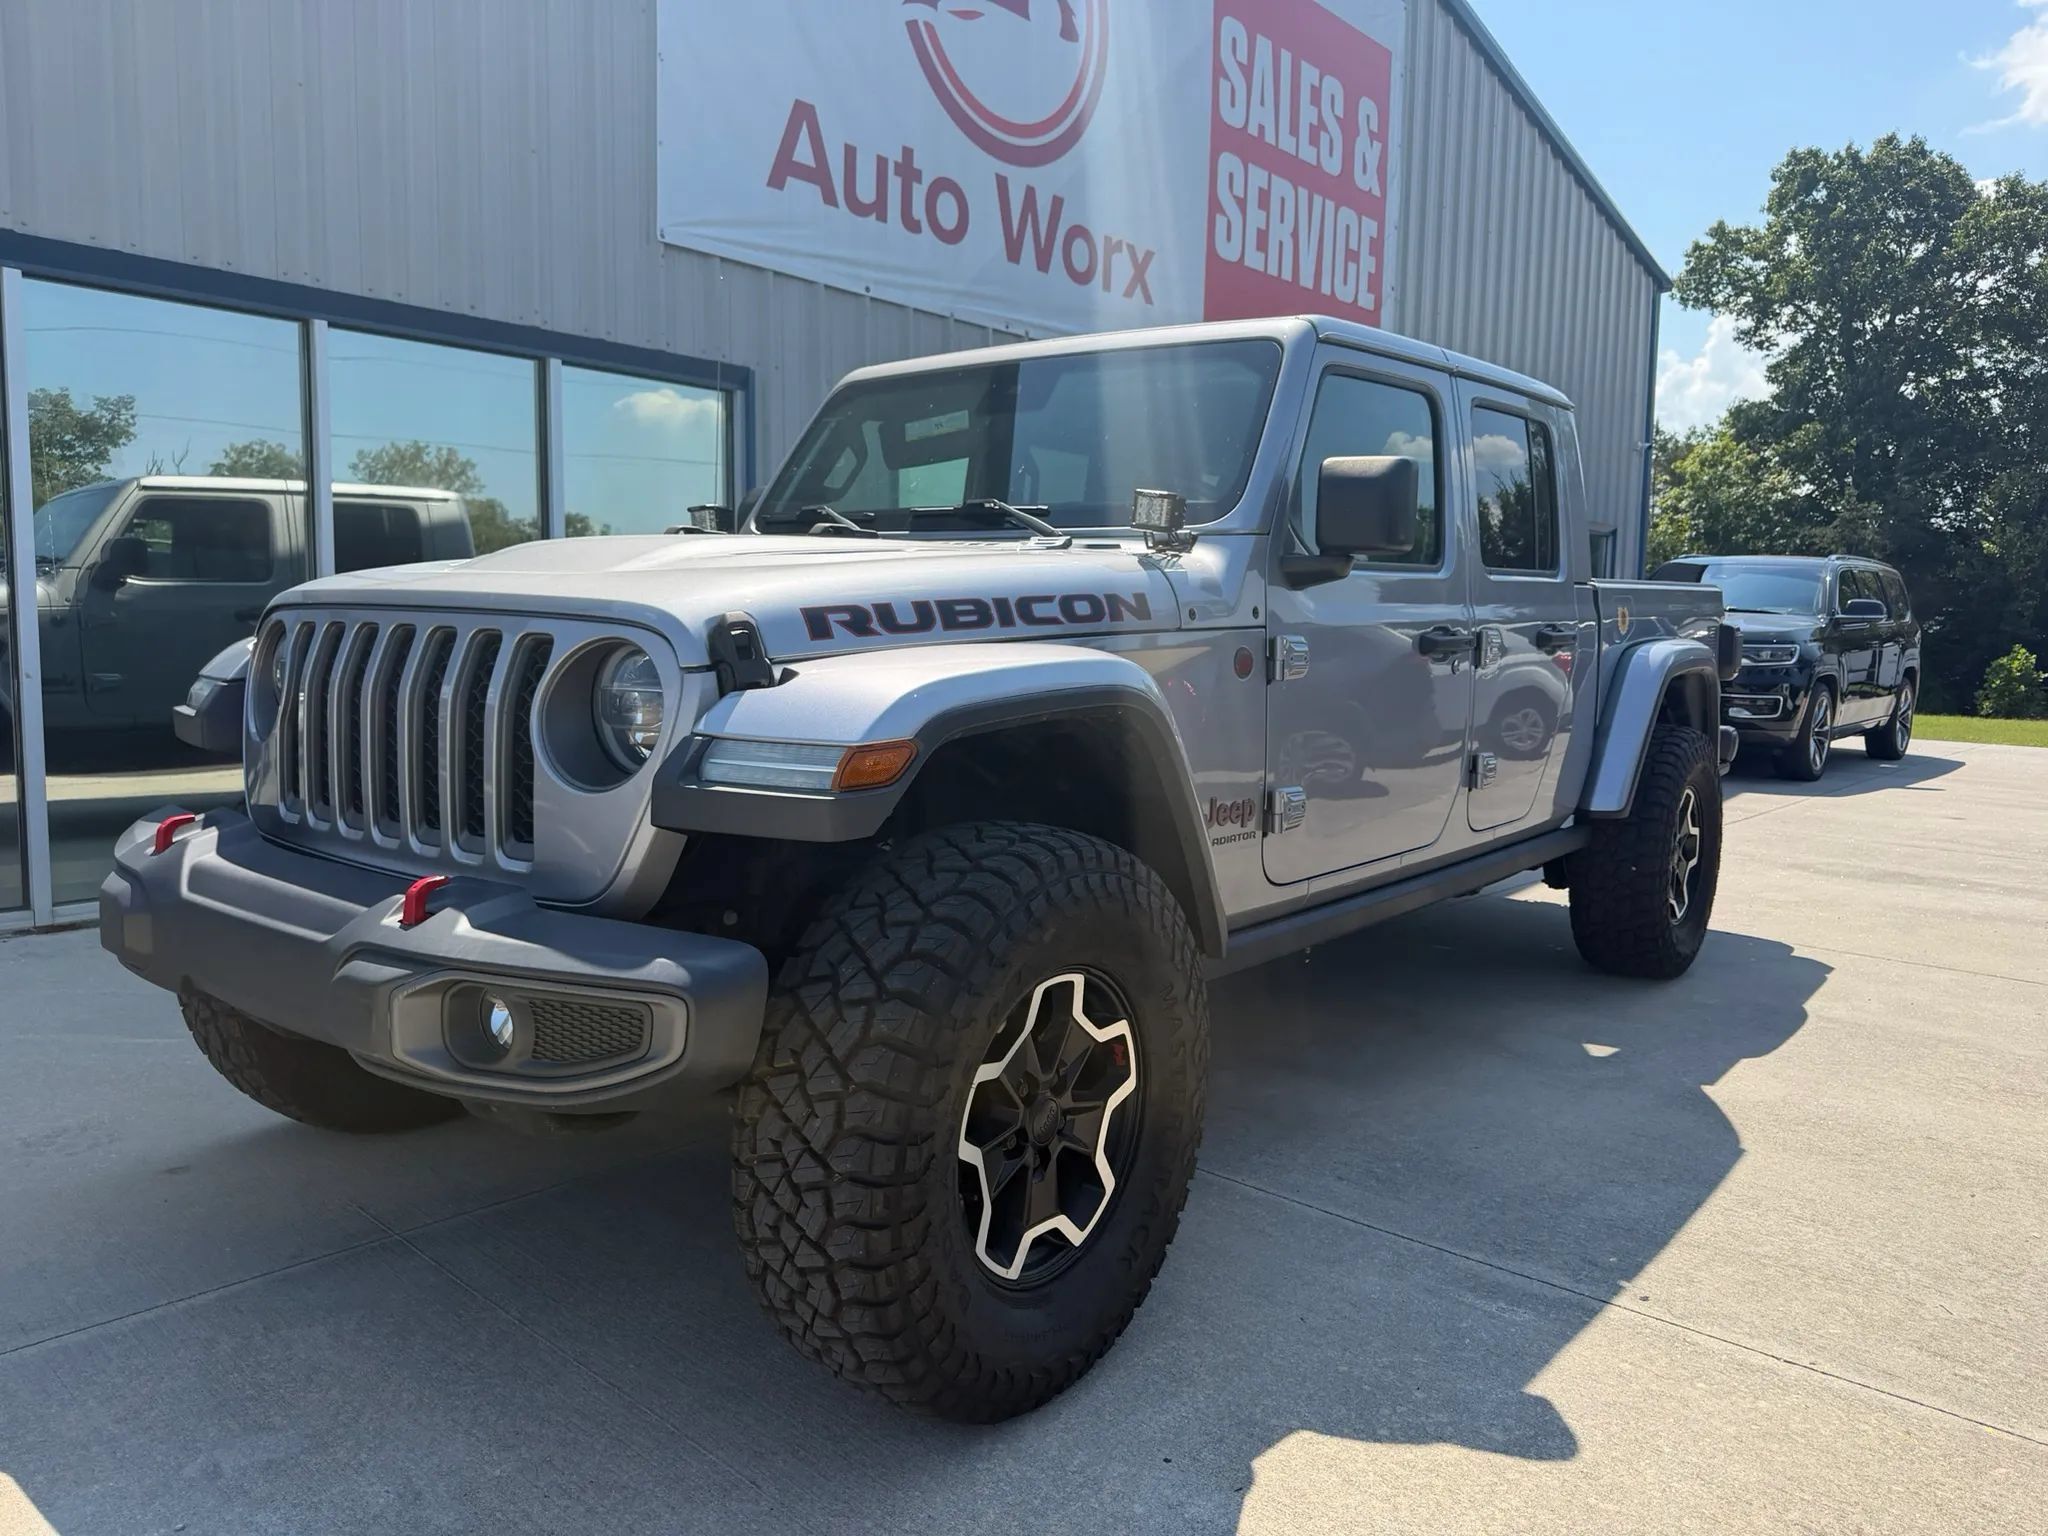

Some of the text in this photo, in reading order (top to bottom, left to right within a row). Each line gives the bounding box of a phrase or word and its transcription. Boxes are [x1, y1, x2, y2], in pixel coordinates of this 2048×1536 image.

[1219, 15, 1383, 197] SALES &
[766, 98, 1156, 306] Auto Worx
[1214, 151, 1377, 311] SERVICE
[800, 592, 1153, 641] RUBICON
[1206, 796, 1256, 829] Jeep
[1212, 830, 1257, 847] ADIATOR
